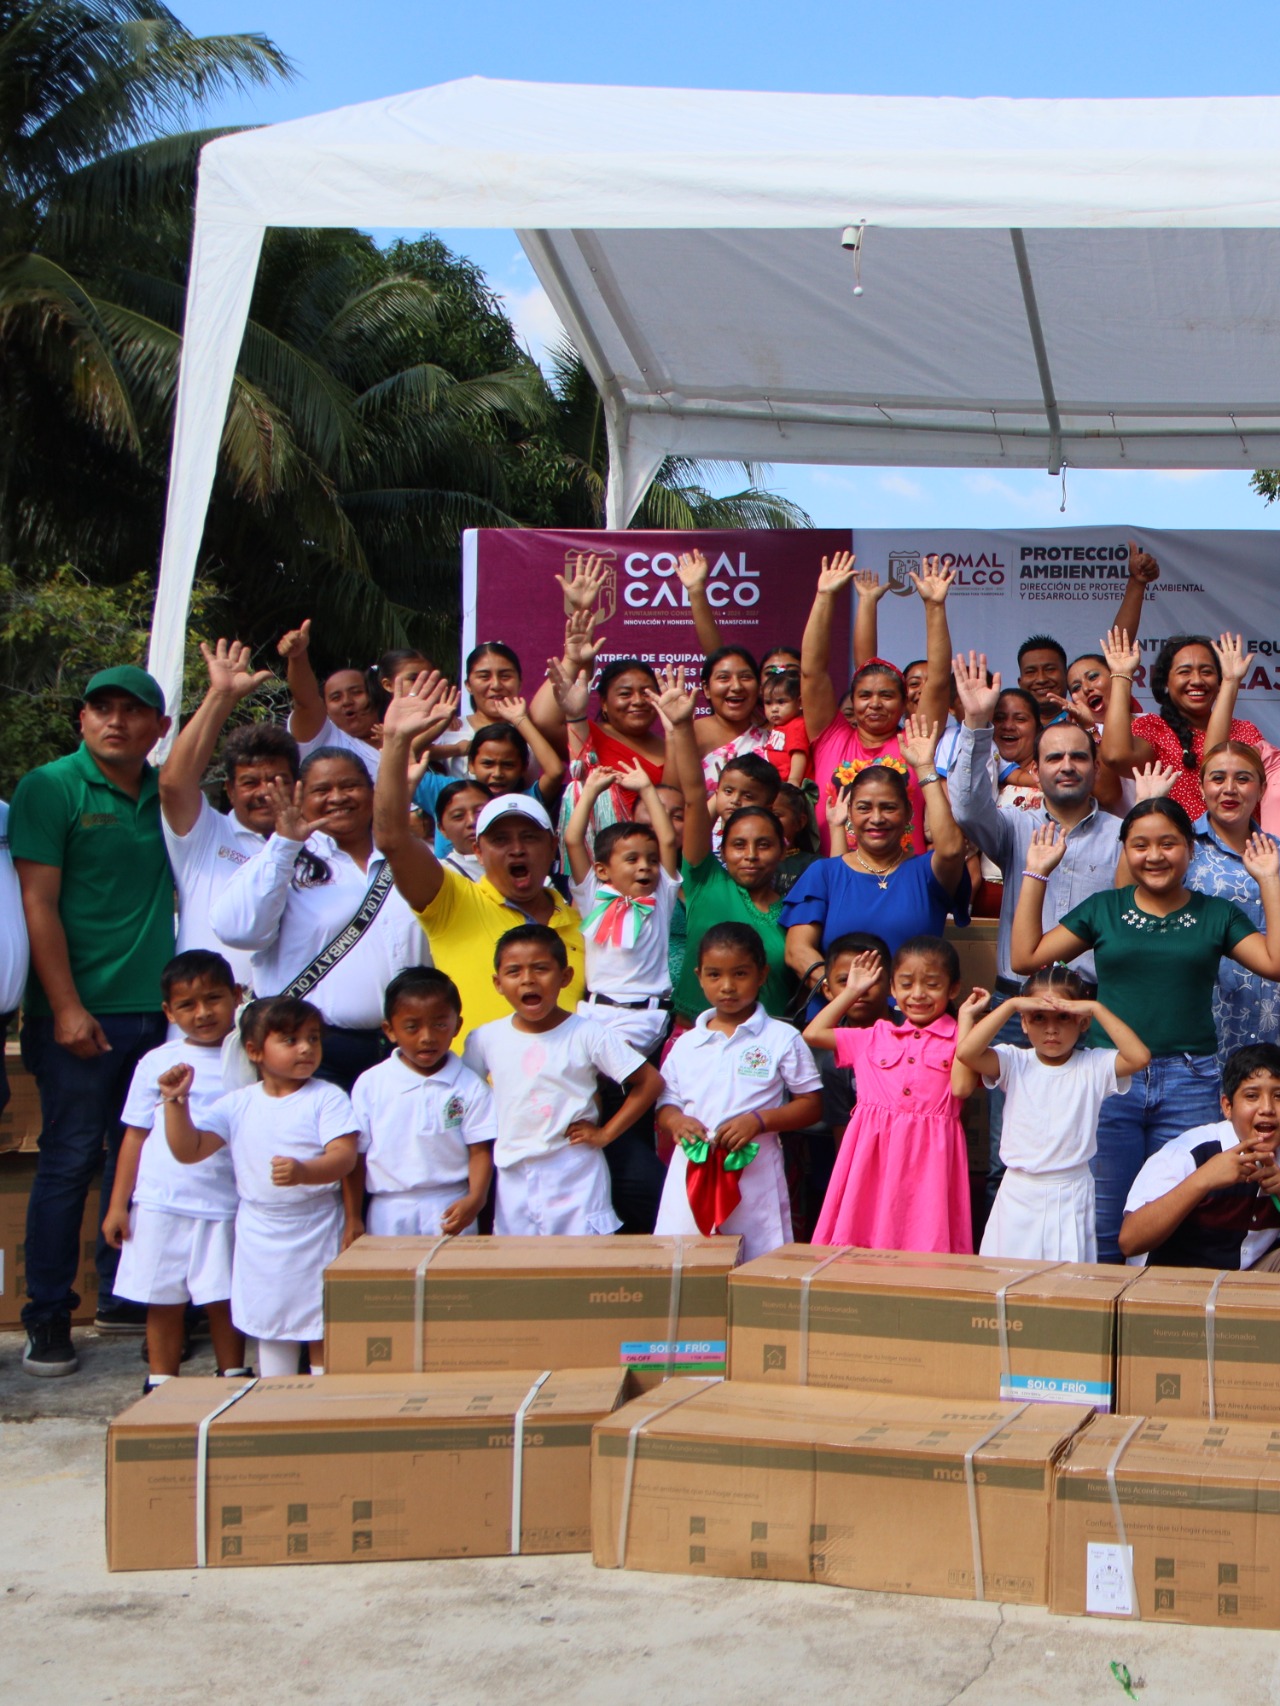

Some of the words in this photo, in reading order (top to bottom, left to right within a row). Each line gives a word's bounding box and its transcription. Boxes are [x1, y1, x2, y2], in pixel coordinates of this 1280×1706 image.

[624, 552, 760, 577] COAL
[1020, 565, 1130, 579] AMBIENTAL
[1020, 582, 1071, 591] DIRECCIÓN
[1089, 584, 1149, 592] PROTECN
[1152, 584, 1205, 592] AMBIENTAL
[1019, 592, 1025, 600] Y
[1026, 592, 1087, 600] DESARROLLO
[596, 654, 637, 662] NTREGA
[641, 654, 655, 662] DE
[659, 654, 708, 663] EQUIPAM
[589, 1287, 644, 1304] mabe
[1153, 1328, 1179, 1337] Nuevos
[1181, 1330, 1199, 1338] Aires
[1201, 1330, 1257, 1341] Andicionados
[685, 1342, 710, 1352] FRÍO
[1027, 1379, 1057, 1390] SOLO
[1062, 1381, 1087, 1393] FRÍO
[1087, 1484, 1108, 1492] Nuevo
[1086, 1520, 1113, 1529] Confort,
[1157, 1524, 1170, 1532] que
[1181, 1526, 1200, 1535] hogar
